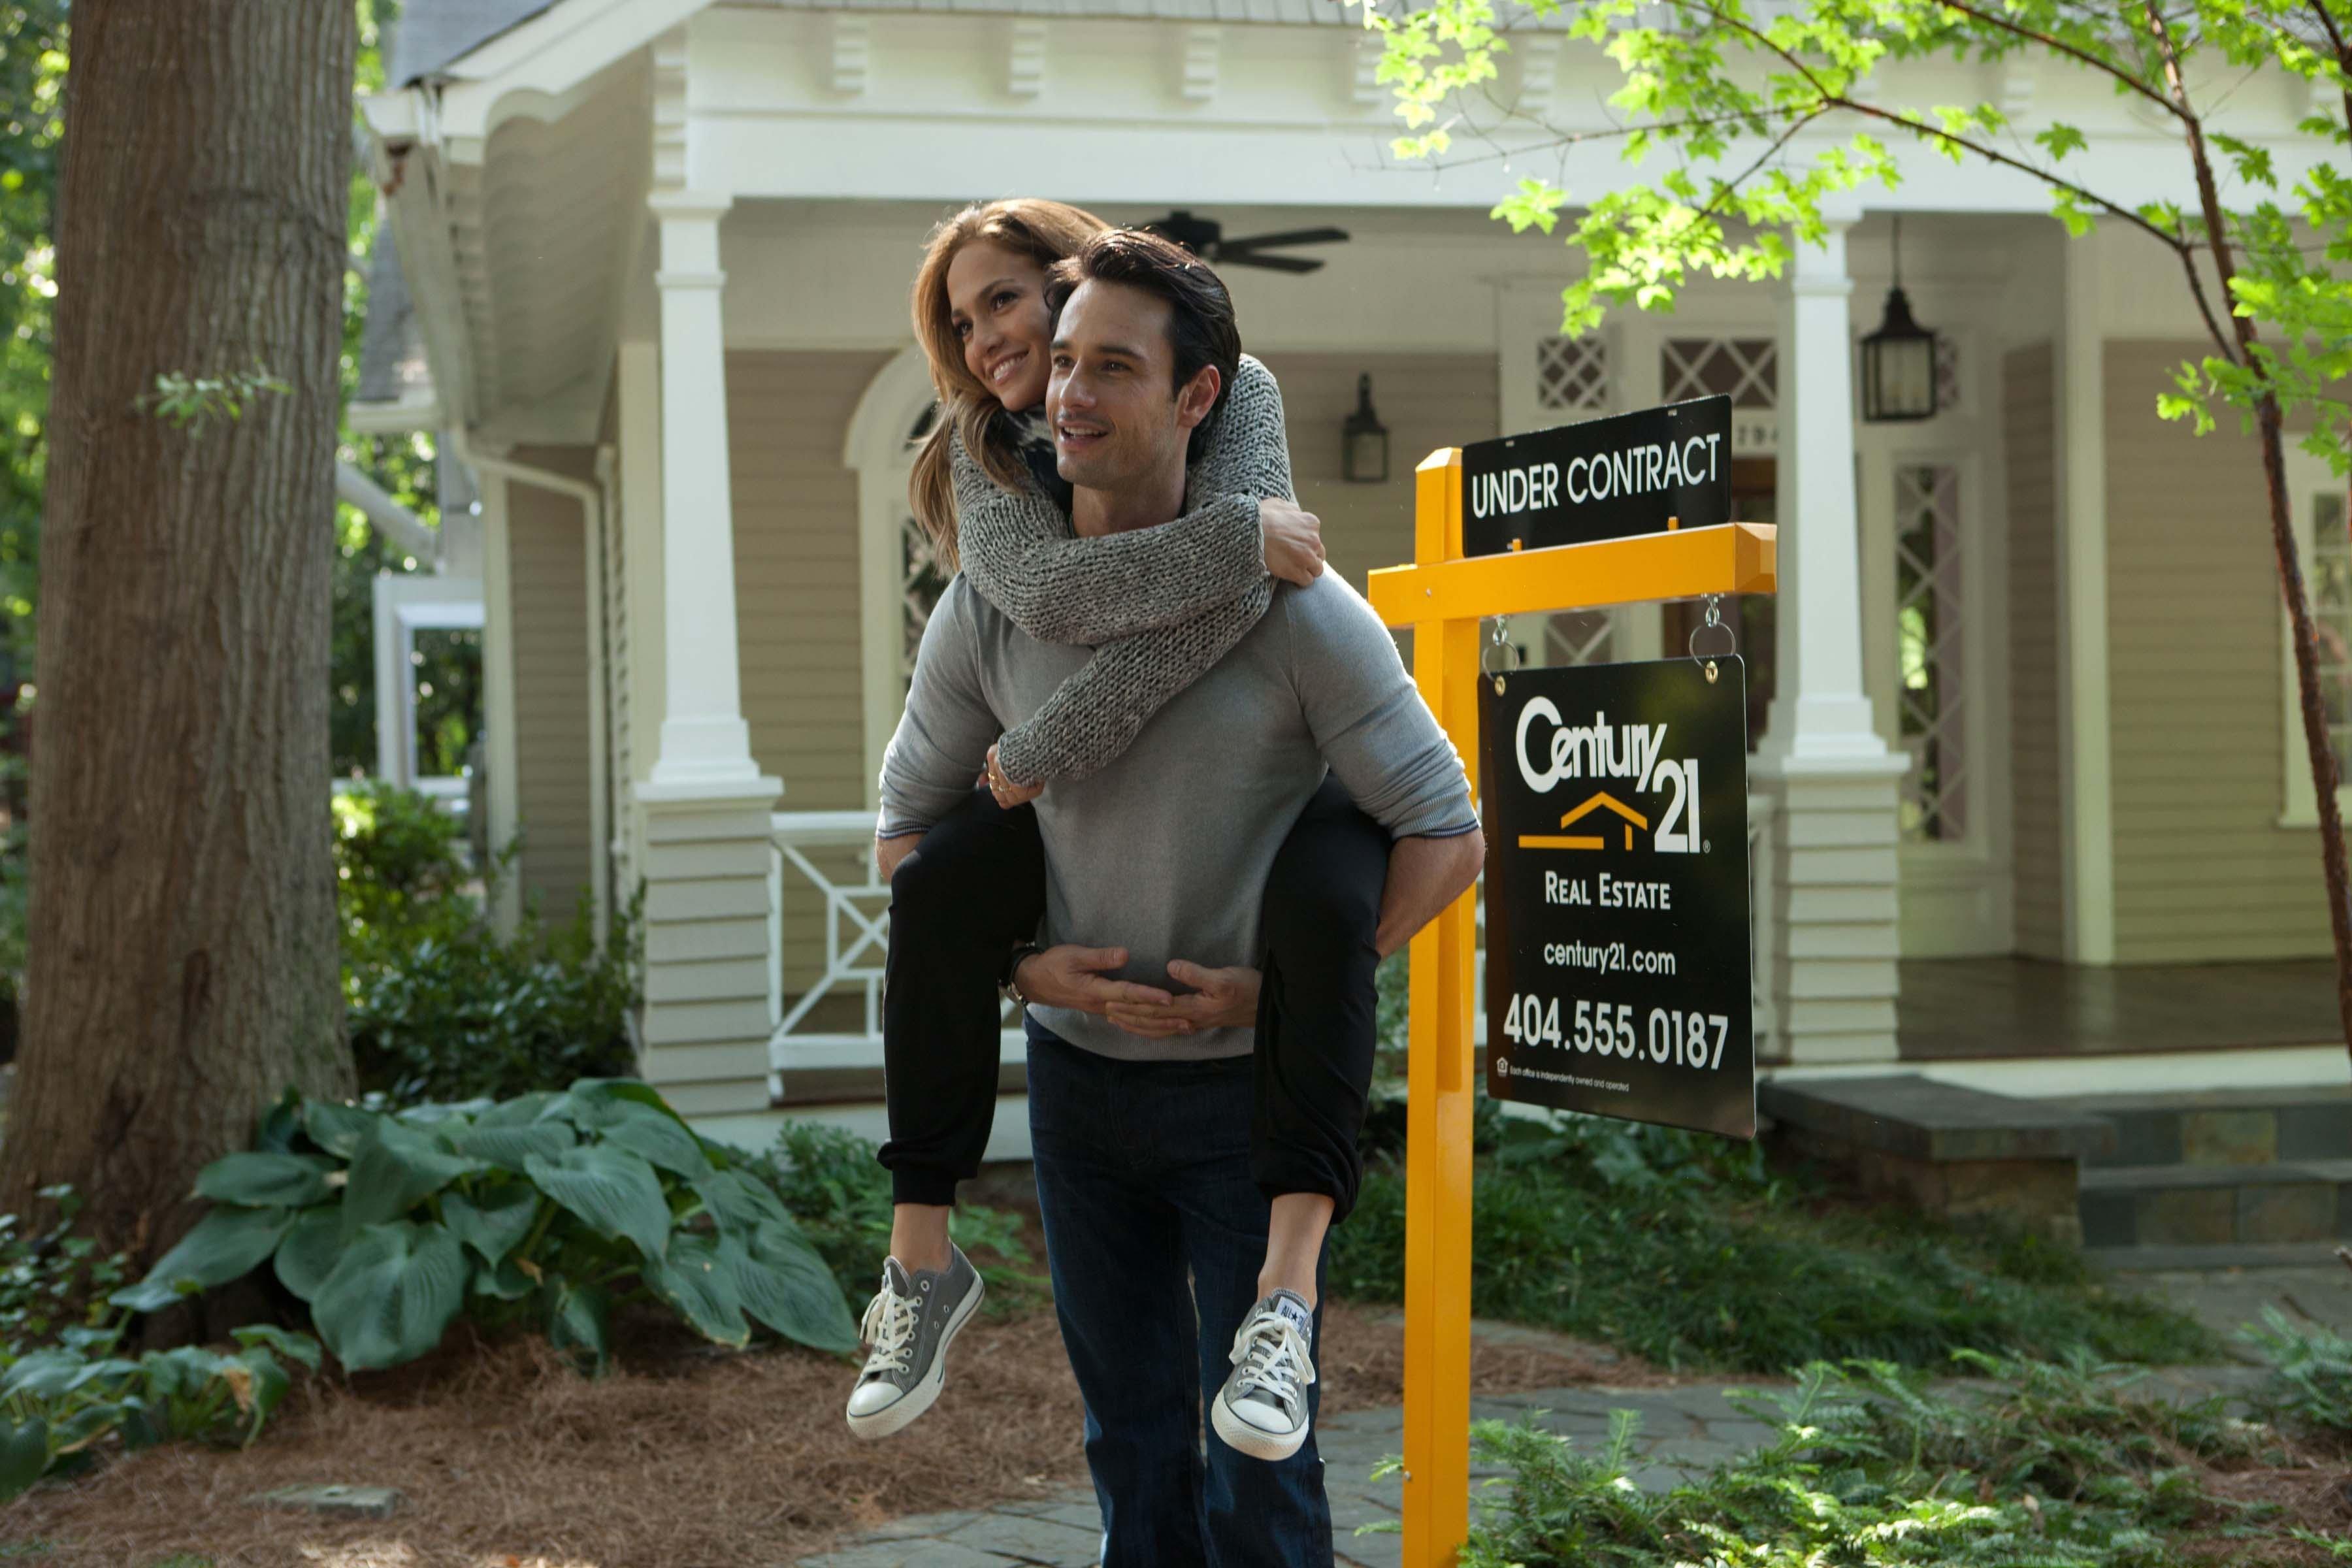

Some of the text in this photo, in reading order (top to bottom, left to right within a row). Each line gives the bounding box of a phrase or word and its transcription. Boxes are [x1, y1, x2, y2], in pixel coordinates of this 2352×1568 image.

[1473, 433, 1720, 519] UNDER CONTRACT
[1516, 696, 1667, 793] Century
[1544, 939, 1676, 975] century21.com
[1503, 993, 1729, 1070] 404.555.0187
[1575, 1077, 1593, 1087] owned
[1593, 1079, 1605, 1088] and
